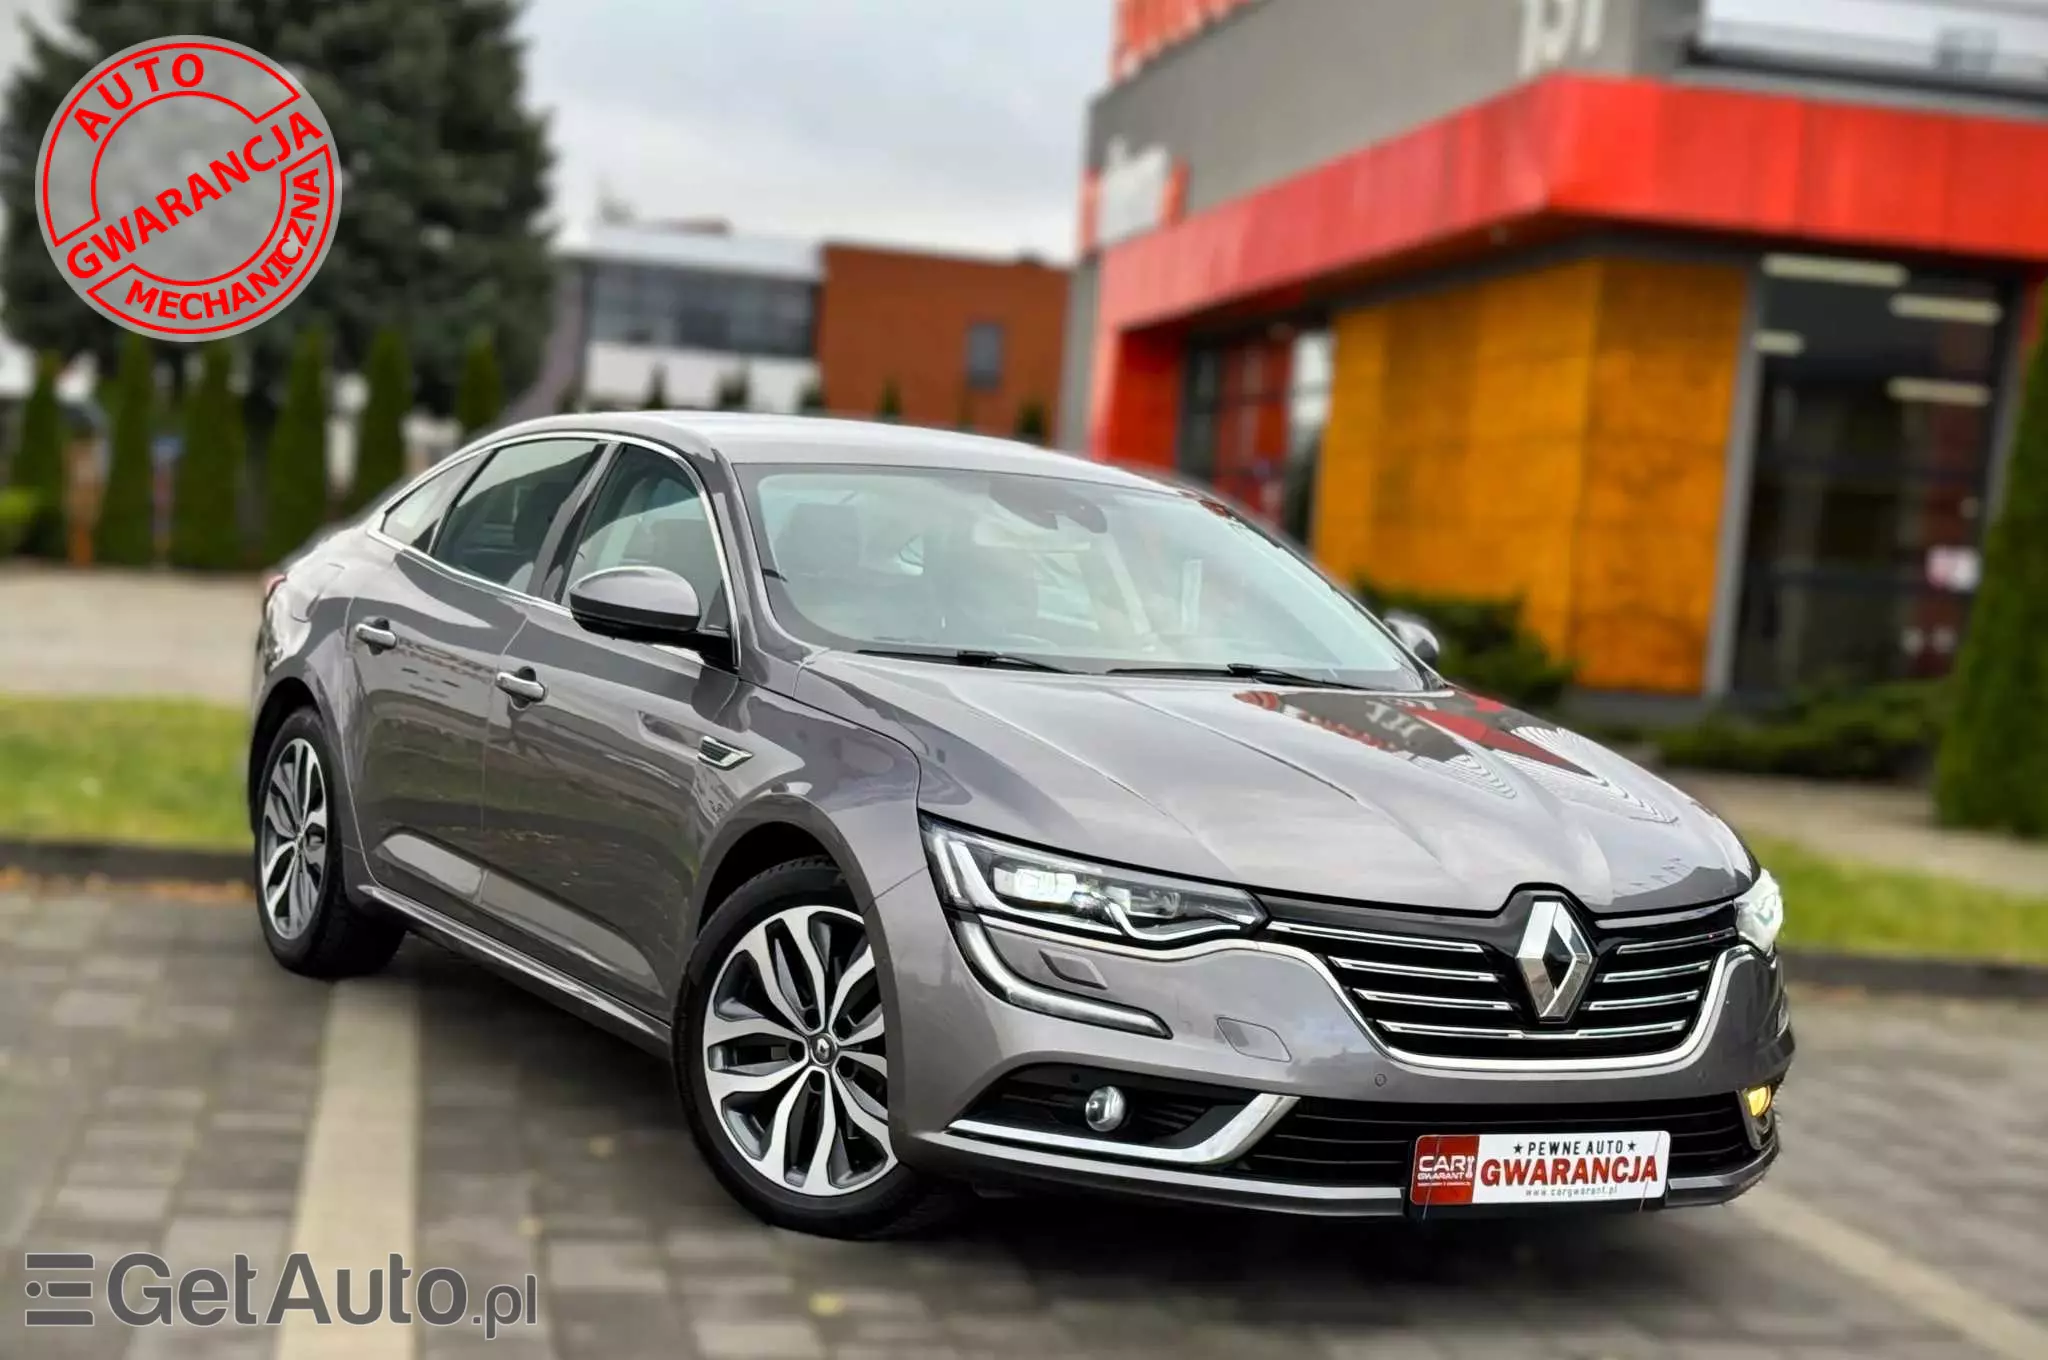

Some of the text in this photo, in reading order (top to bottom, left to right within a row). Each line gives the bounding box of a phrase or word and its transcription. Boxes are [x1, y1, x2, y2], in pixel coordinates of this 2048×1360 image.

[1527, 1139, 1624, 1156] PEWNE AUTO
[1418, 1155, 1466, 1172] CAR
[1480, 1155, 1659, 1187] GWARANCJA
